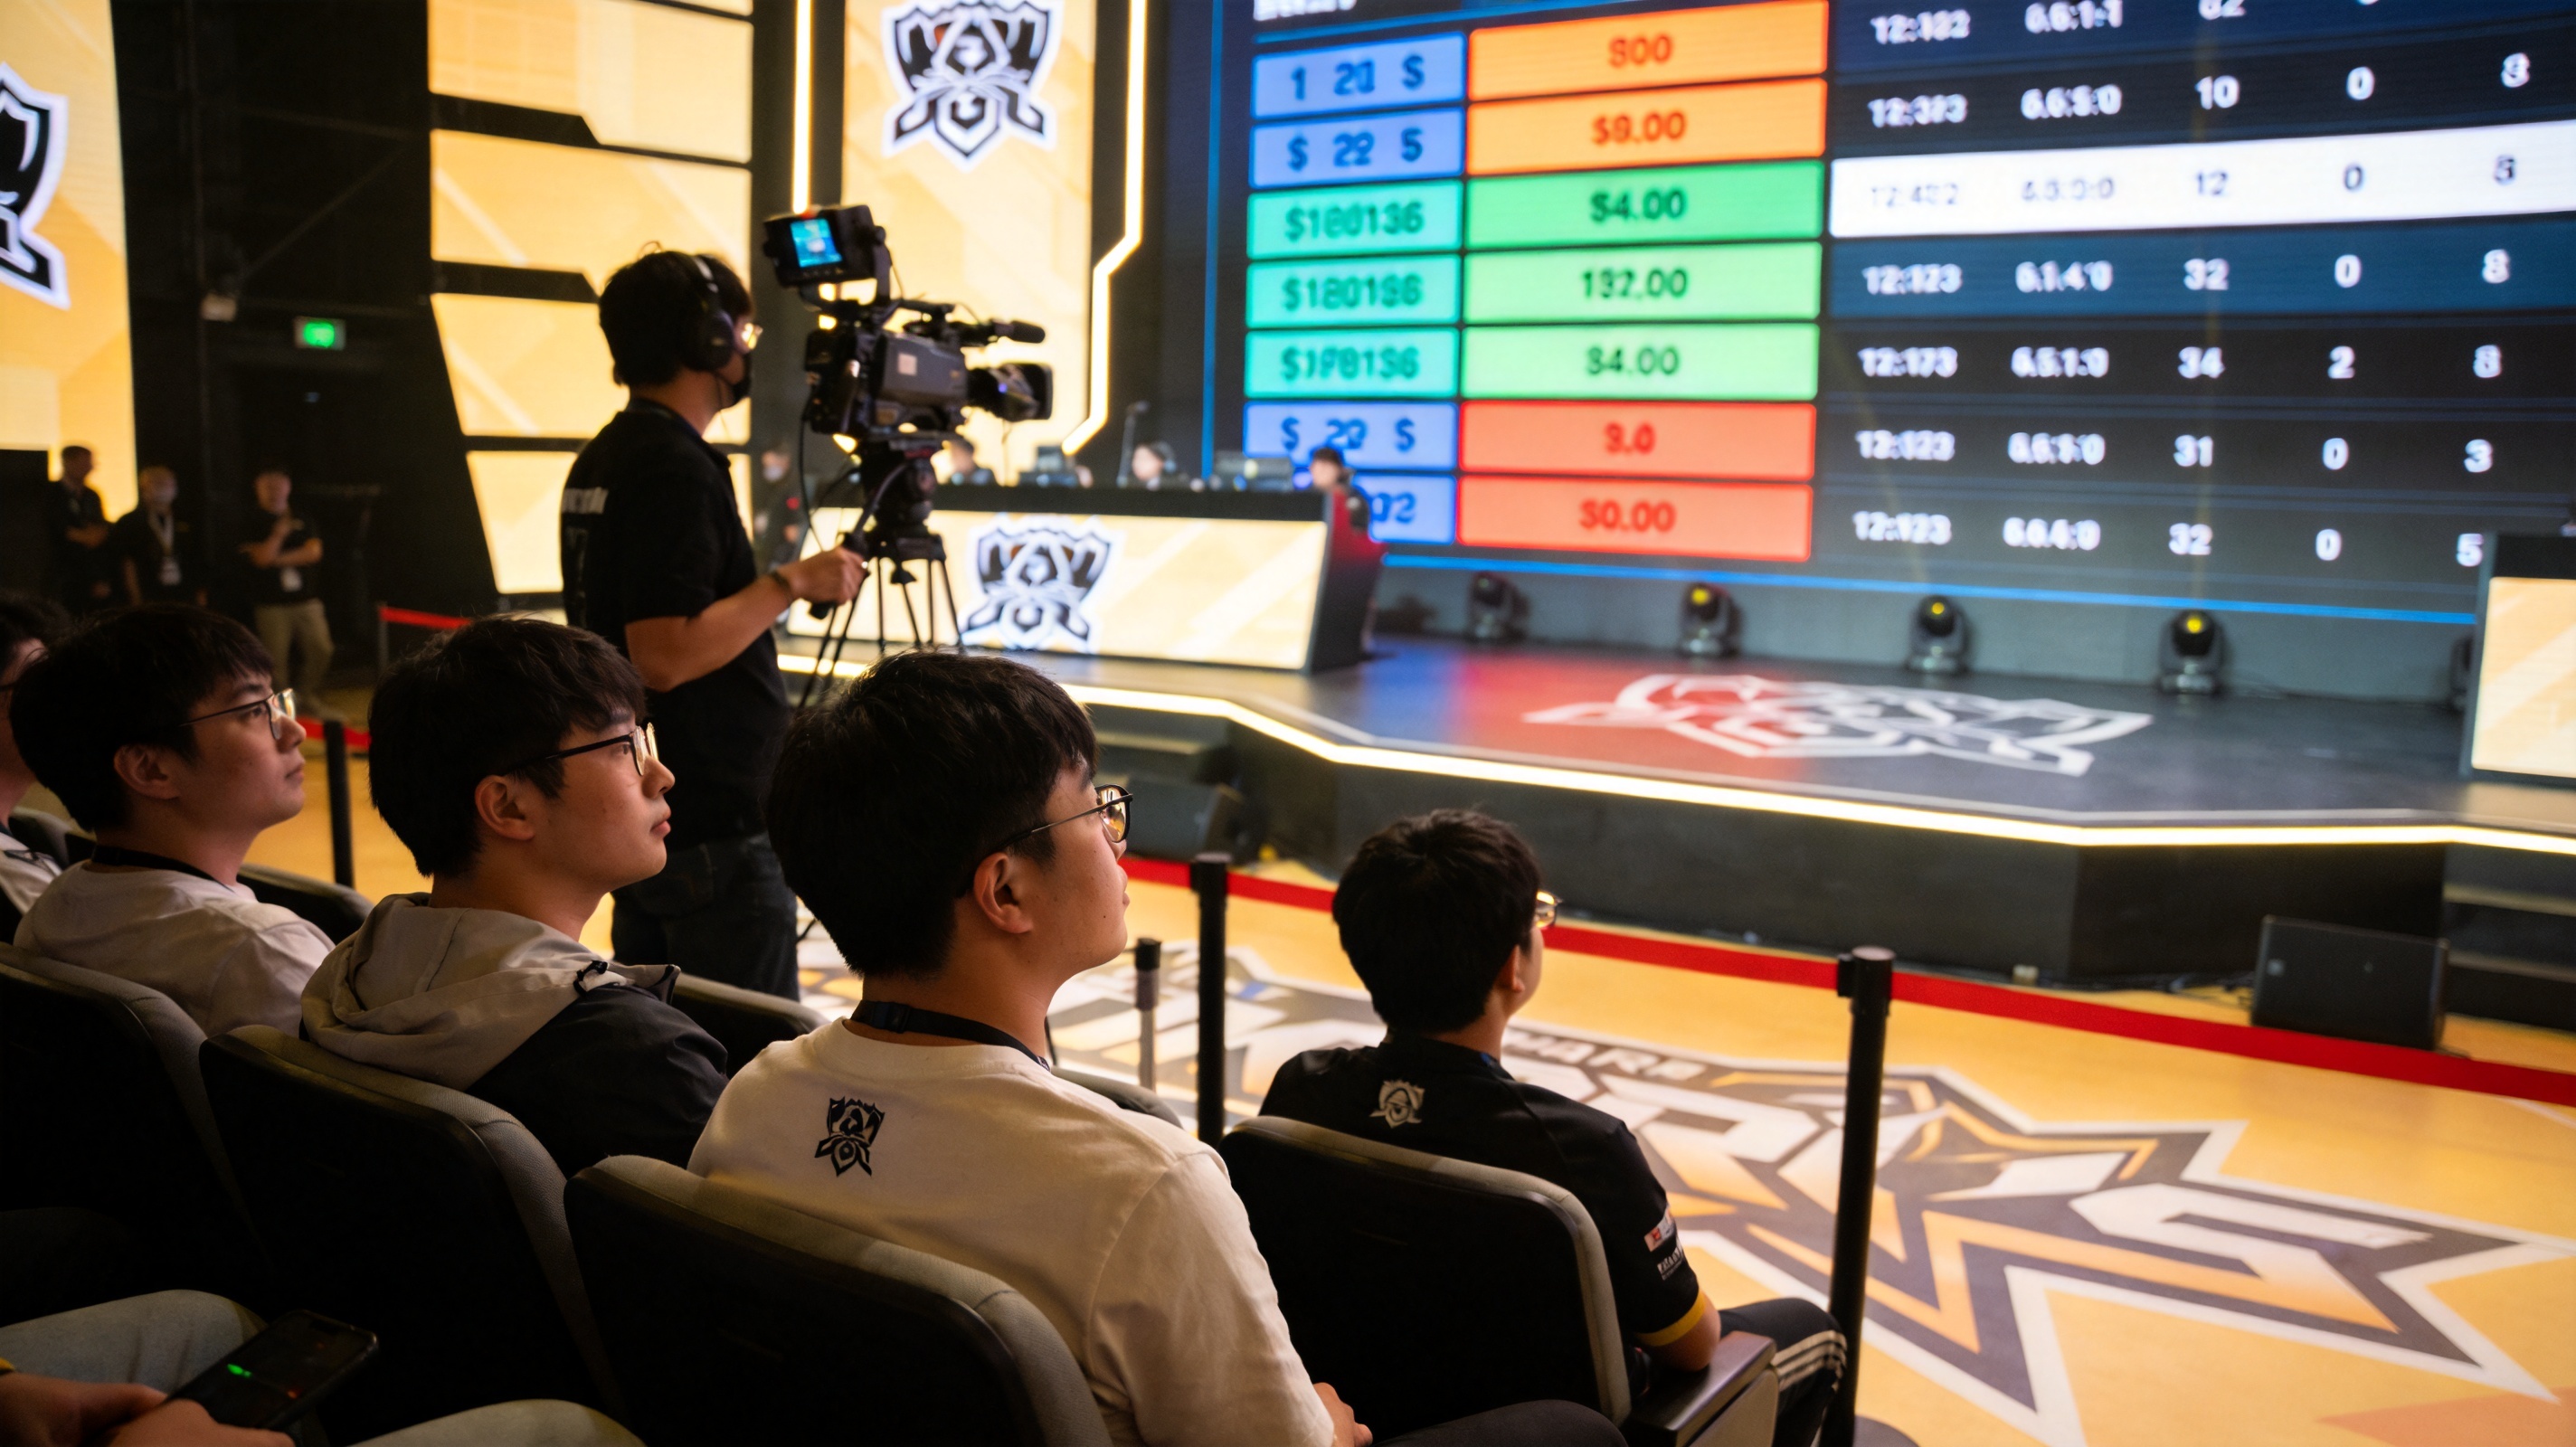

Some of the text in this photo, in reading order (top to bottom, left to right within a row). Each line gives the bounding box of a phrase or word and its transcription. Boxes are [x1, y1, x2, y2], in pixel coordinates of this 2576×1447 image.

[2196, 75, 2240, 109] 10
[2346, 66, 2375, 99] 0
[2343, 165, 2364, 192] 0
[2183, 258, 2230, 291] 32
[2334, 254, 2362, 288] 0
[2178, 345, 2225, 379] 34
[2327, 345, 2355, 380] 2
[2173, 434, 2213, 468] 31
[2322, 437, 2349, 470] 0
[2464, 439, 2494, 473] 3
[2169, 522, 2213, 555] 32
[2316, 528, 2342, 562] 0
[2457, 533, 2484, 567] 5
